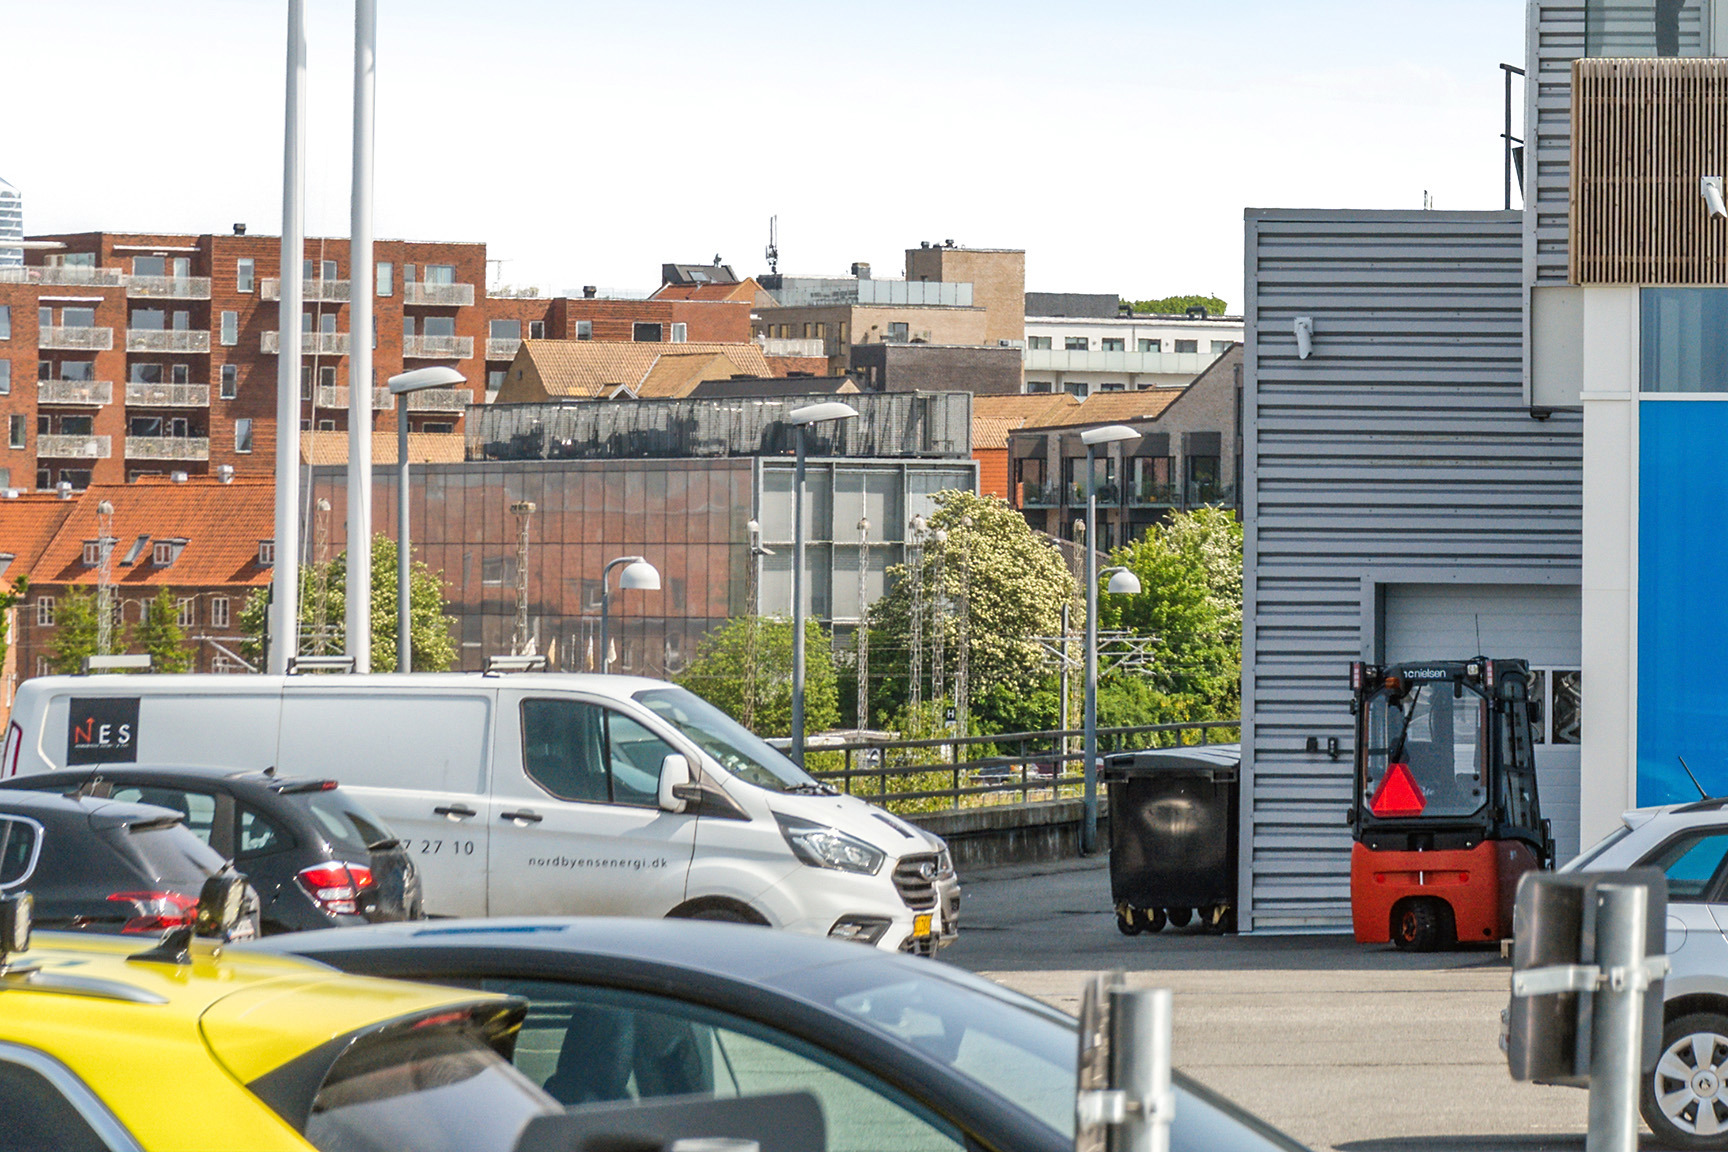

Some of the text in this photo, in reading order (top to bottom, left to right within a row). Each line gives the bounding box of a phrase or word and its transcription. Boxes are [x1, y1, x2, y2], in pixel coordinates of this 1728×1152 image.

[947, 709, 955, 719] H
[74, 717, 131, 745] NES
[421, 840, 443, 854] 27
[453, 841, 475, 855] 10
[528, 855, 668, 871] nordbyensenergi.dk
